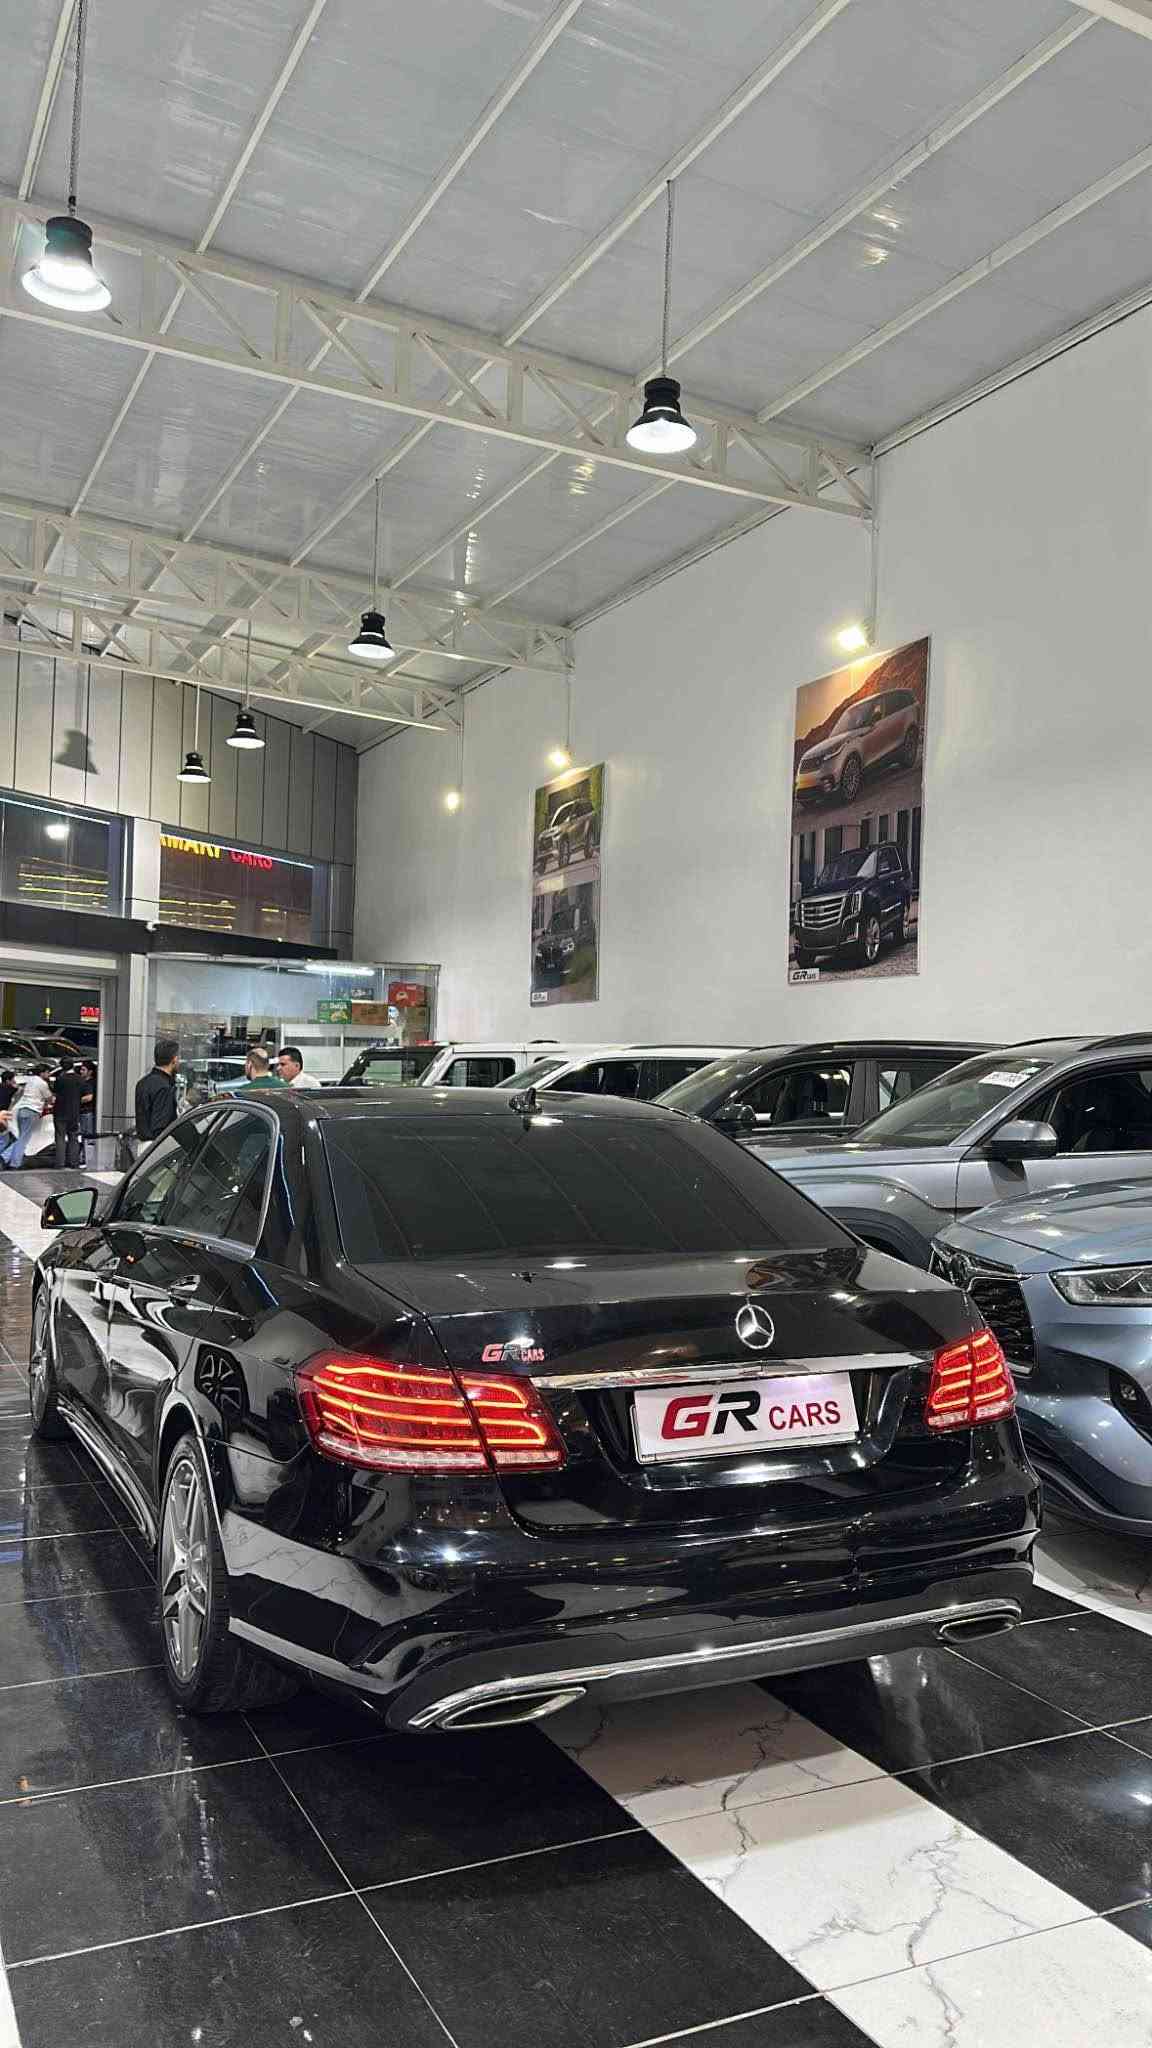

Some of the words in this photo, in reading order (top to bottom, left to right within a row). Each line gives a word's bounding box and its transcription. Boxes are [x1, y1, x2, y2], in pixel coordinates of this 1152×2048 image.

[482, 1343, 521, 1362] GR
[521, 1347, 545, 1362] CARS
[661, 1390, 761, 1440] GR
[768, 1400, 841, 1431] CARS
